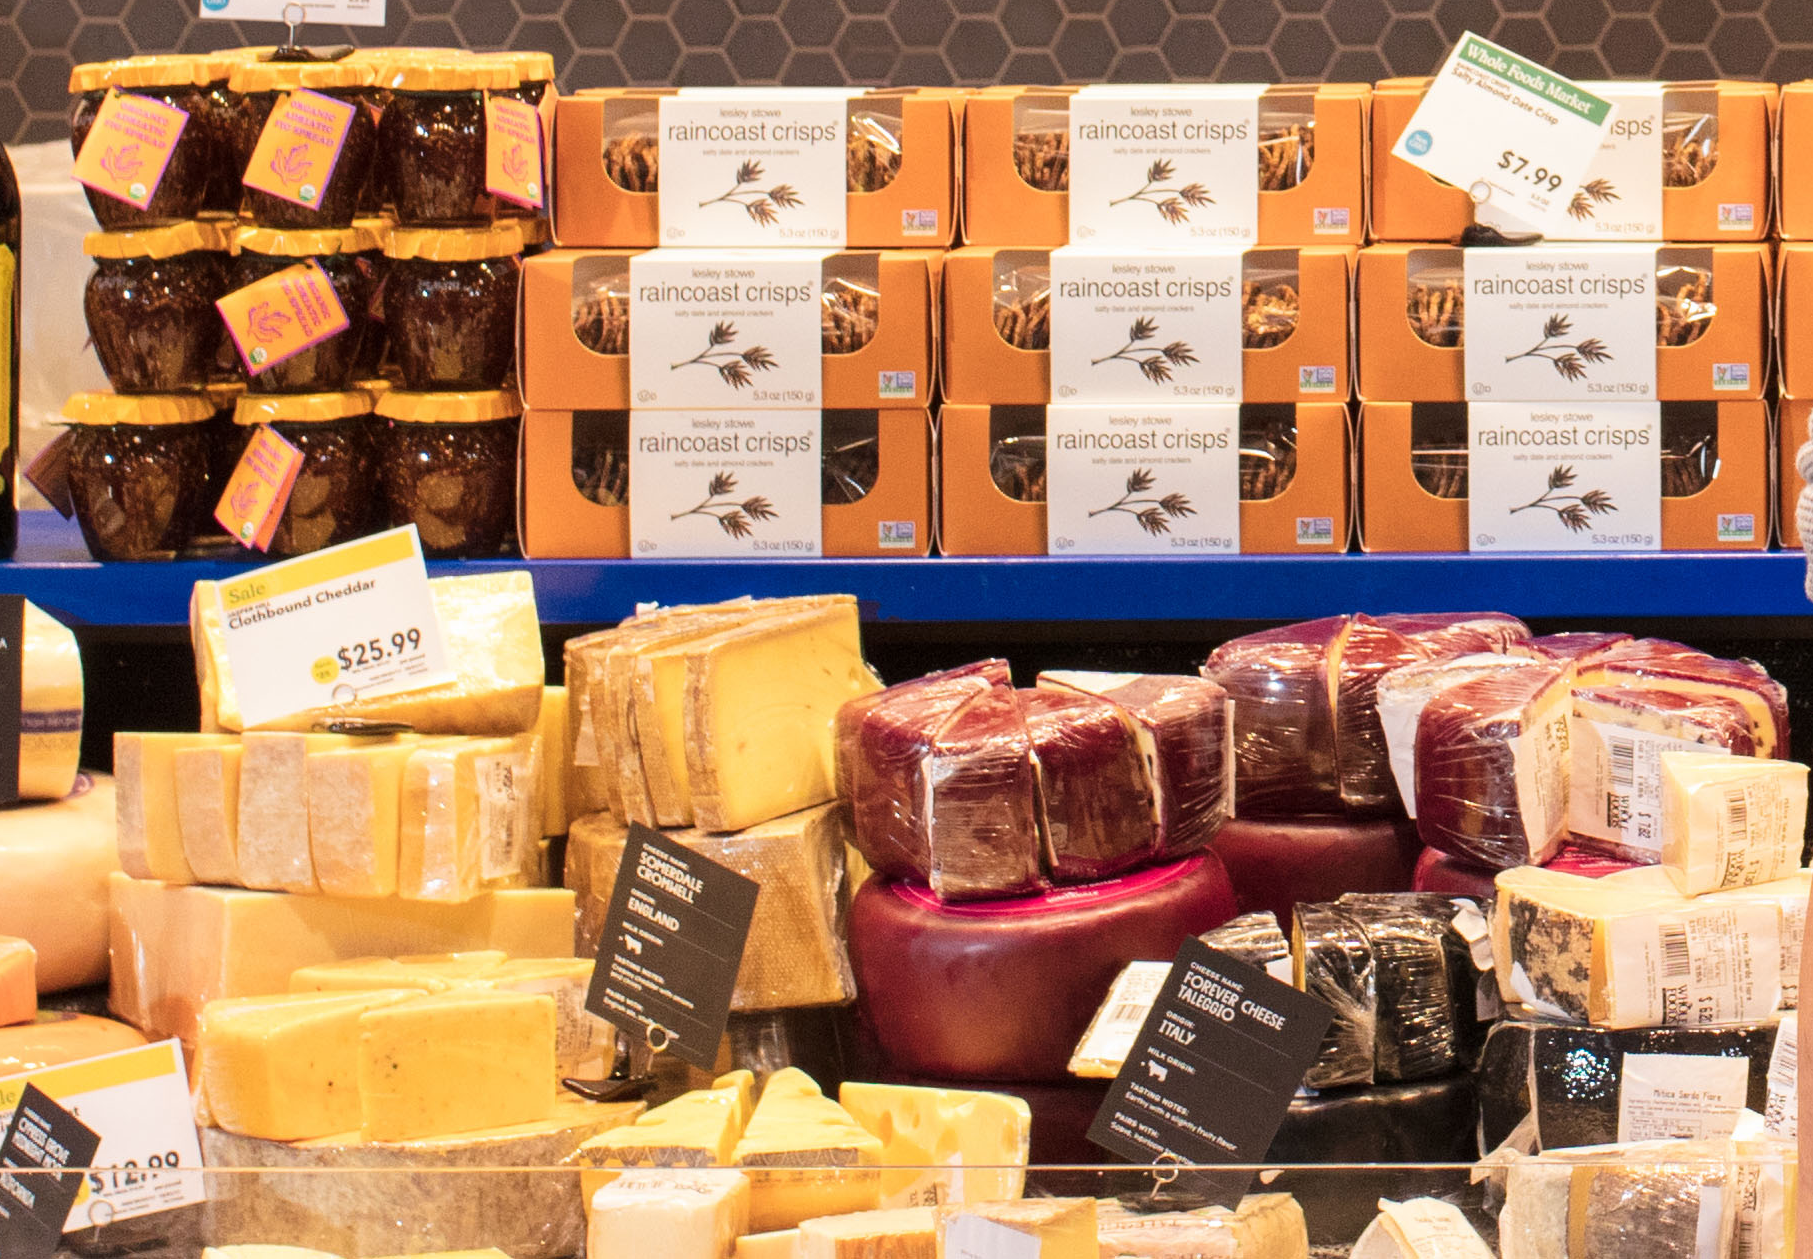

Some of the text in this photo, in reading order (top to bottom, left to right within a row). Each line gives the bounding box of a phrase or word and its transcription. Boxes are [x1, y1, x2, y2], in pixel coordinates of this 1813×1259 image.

[1467, 42, 1594, 113] Whole Foods Market
[1451, 67, 1559, 126] Salty Almond Date Crisp
[1130, 107, 1192, 118] lesley stowe
[668, 121, 837, 145] raincoast crisps
[1079, 120, 1248, 144] raincoast crisps
[1610, 116, 1653, 140] isps
[1497, 150, 1562, 192] $7.99
[1526, 261, 1589, 272] lesley stowe
[639, 281, 811, 306] raincoast crisps
[1060, 277, 1232, 302] raincoast crisps
[1474, 275, 1646, 299] raincoast crisps
[1530, 412, 1594, 424] lesley stowe
[639, 432, 811, 457] raincoast crisps
[1056, 429, 1229, 453] raincoast crisps
[1478, 426, 1650, 450] raincoast crisps
[228, 583, 266, 605] Sale
[228, 579, 377, 630] Clothbound Cheddar
[338, 627, 421, 671] $25.99
[637, 865, 694, 904] CROMWELL
[640, 851, 704, 893] SOMERDALE
[628, 896, 680, 932] ENGLAND
[1177, 985, 1235, 1022] TALEGGIO
[1184, 970, 1287, 1031] FOREVER CHEESE
[1158, 1019, 1196, 1046] ITALY
